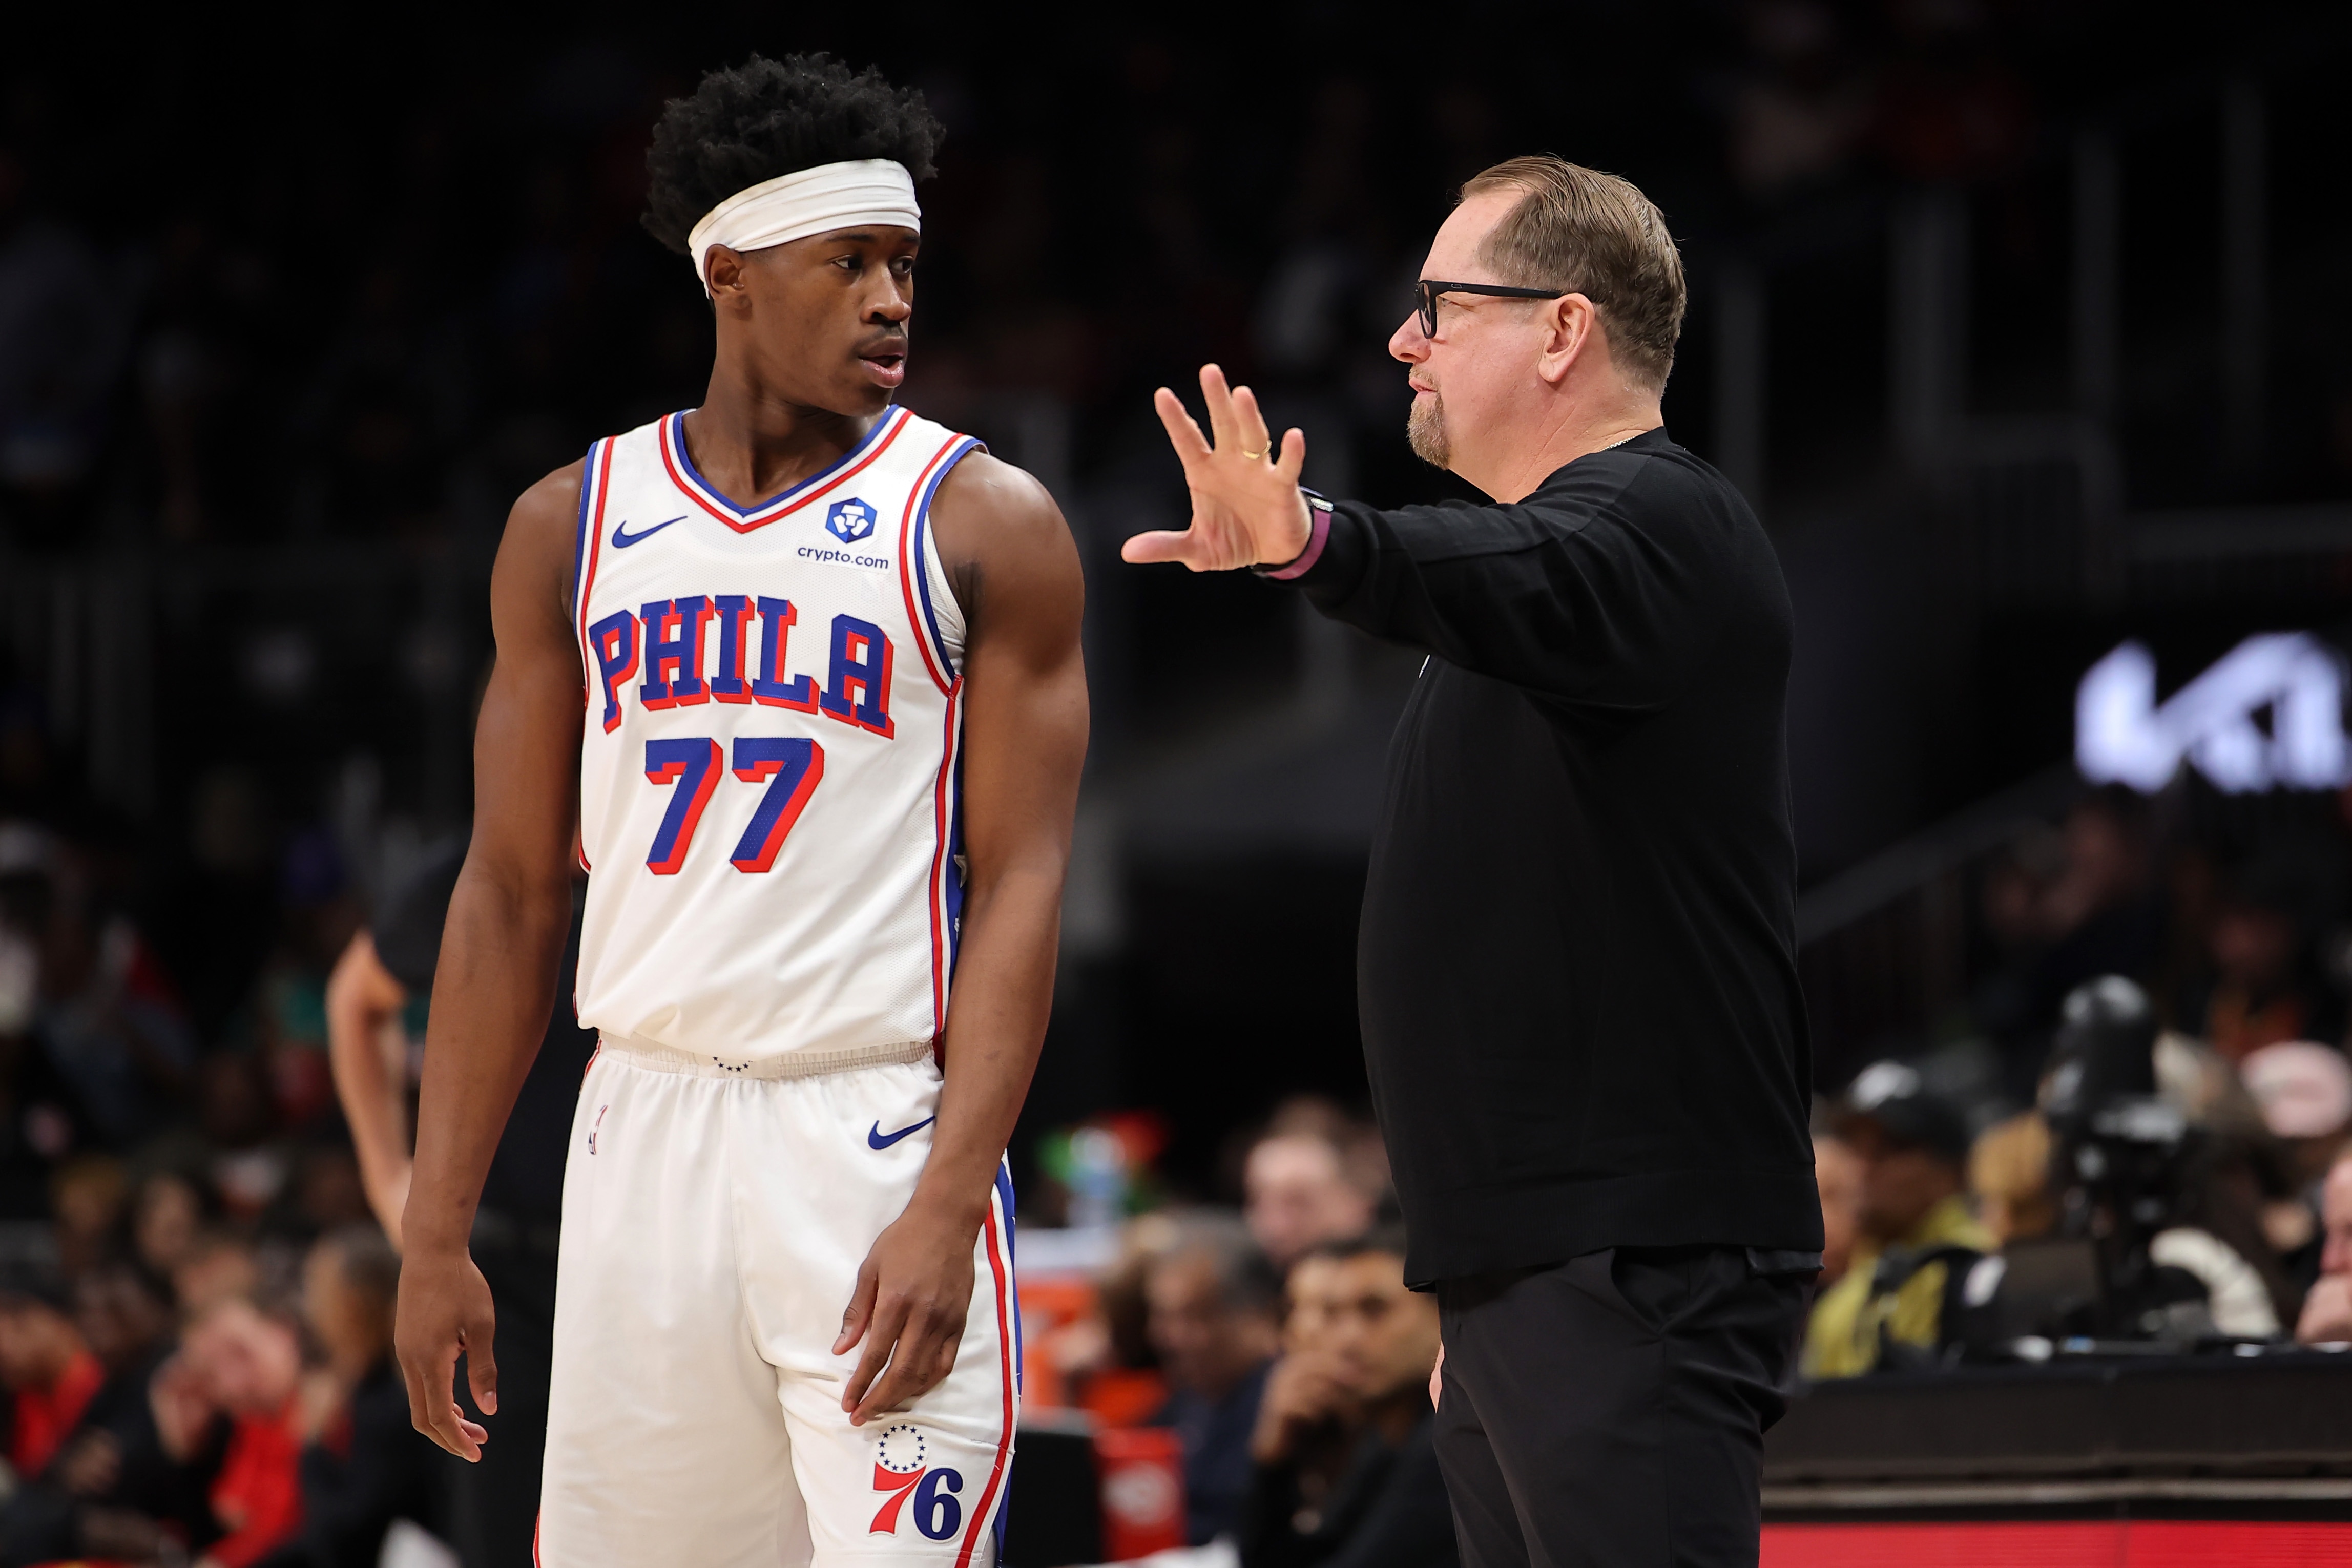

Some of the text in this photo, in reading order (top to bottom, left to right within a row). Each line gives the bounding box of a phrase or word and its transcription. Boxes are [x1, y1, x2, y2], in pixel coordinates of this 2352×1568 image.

[797, 547, 889, 569] crypto.com
[589, 595, 894, 740] PHILA
[644, 737, 824, 875] 77
[869, 1461, 963, 1540] 76
